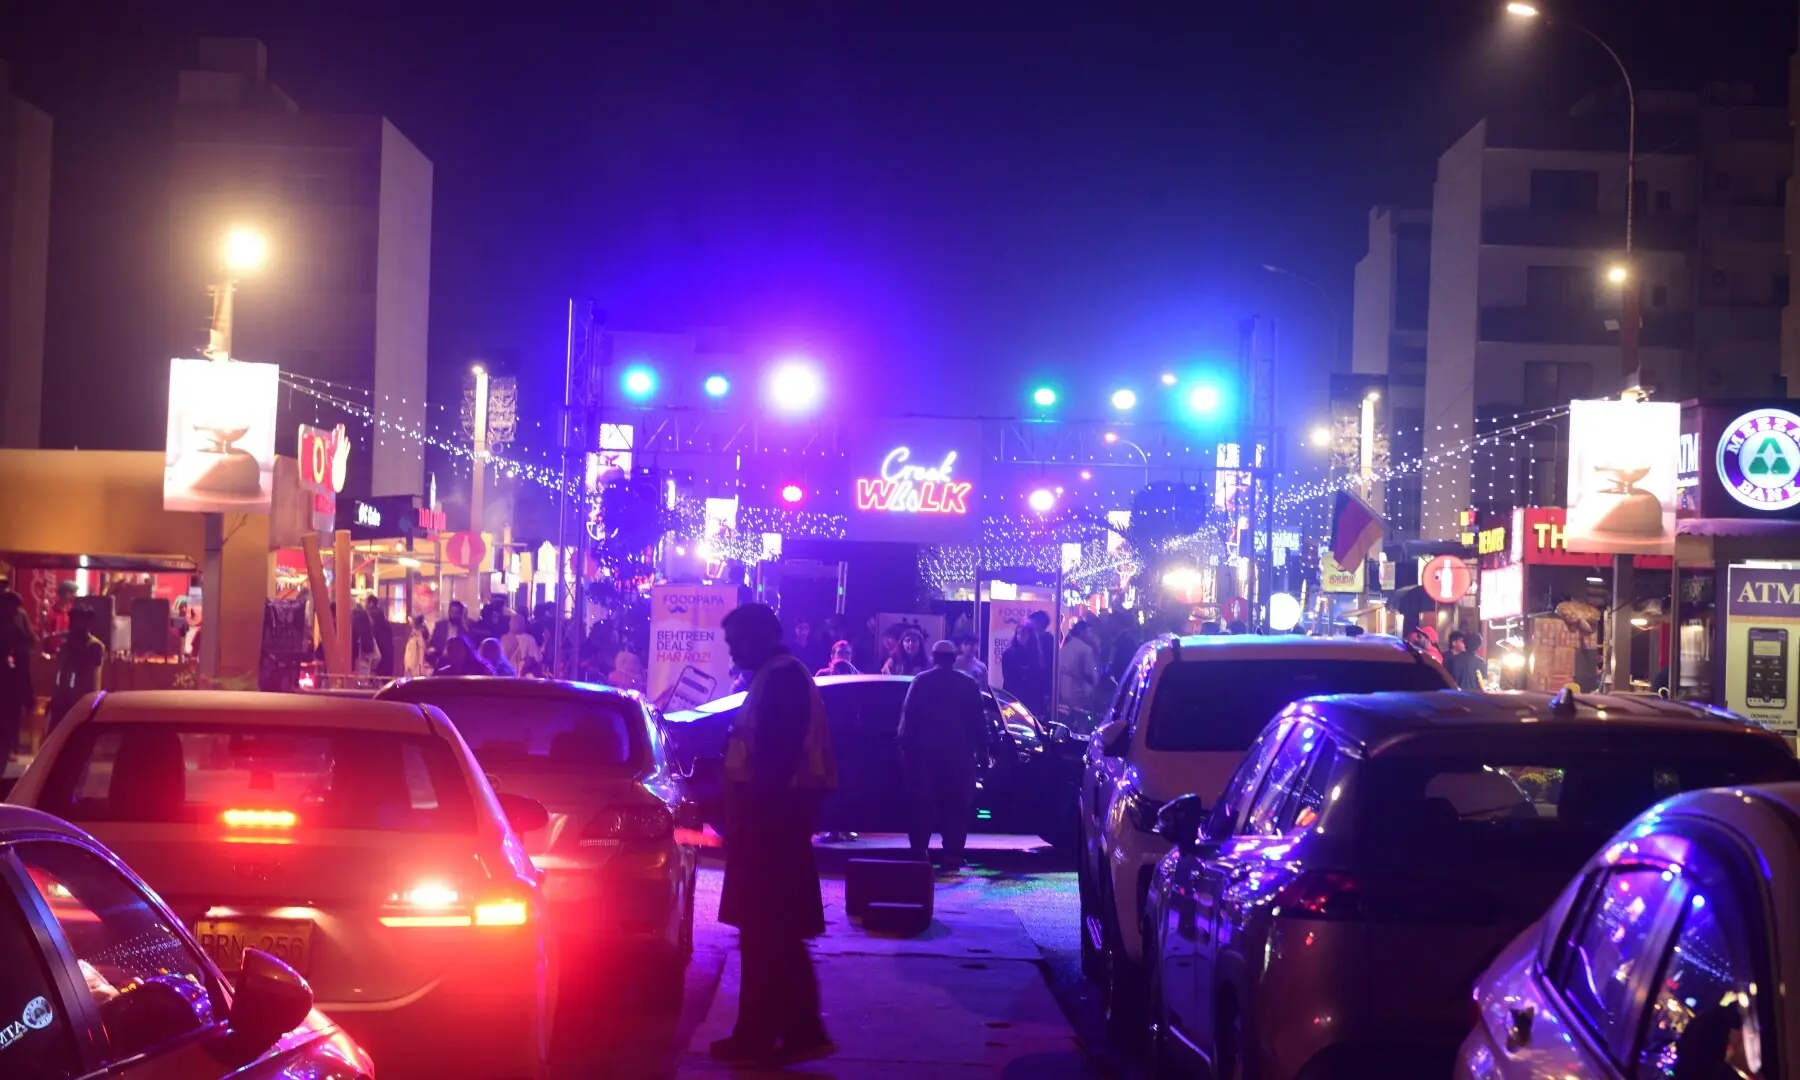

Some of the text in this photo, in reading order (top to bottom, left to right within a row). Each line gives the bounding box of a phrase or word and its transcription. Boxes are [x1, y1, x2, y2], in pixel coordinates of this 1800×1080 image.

[881, 446, 958, 483] Creek
[857, 479, 971, 513] WALK
[1736, 580, 1800, 604] ATM
[663, 594, 725, 605] FOODPAPA
[657, 630, 715, 641] BEHTREEN
[656, 641, 693, 651] DEALS
[656, 651, 711, 662] HAR ROZ!
